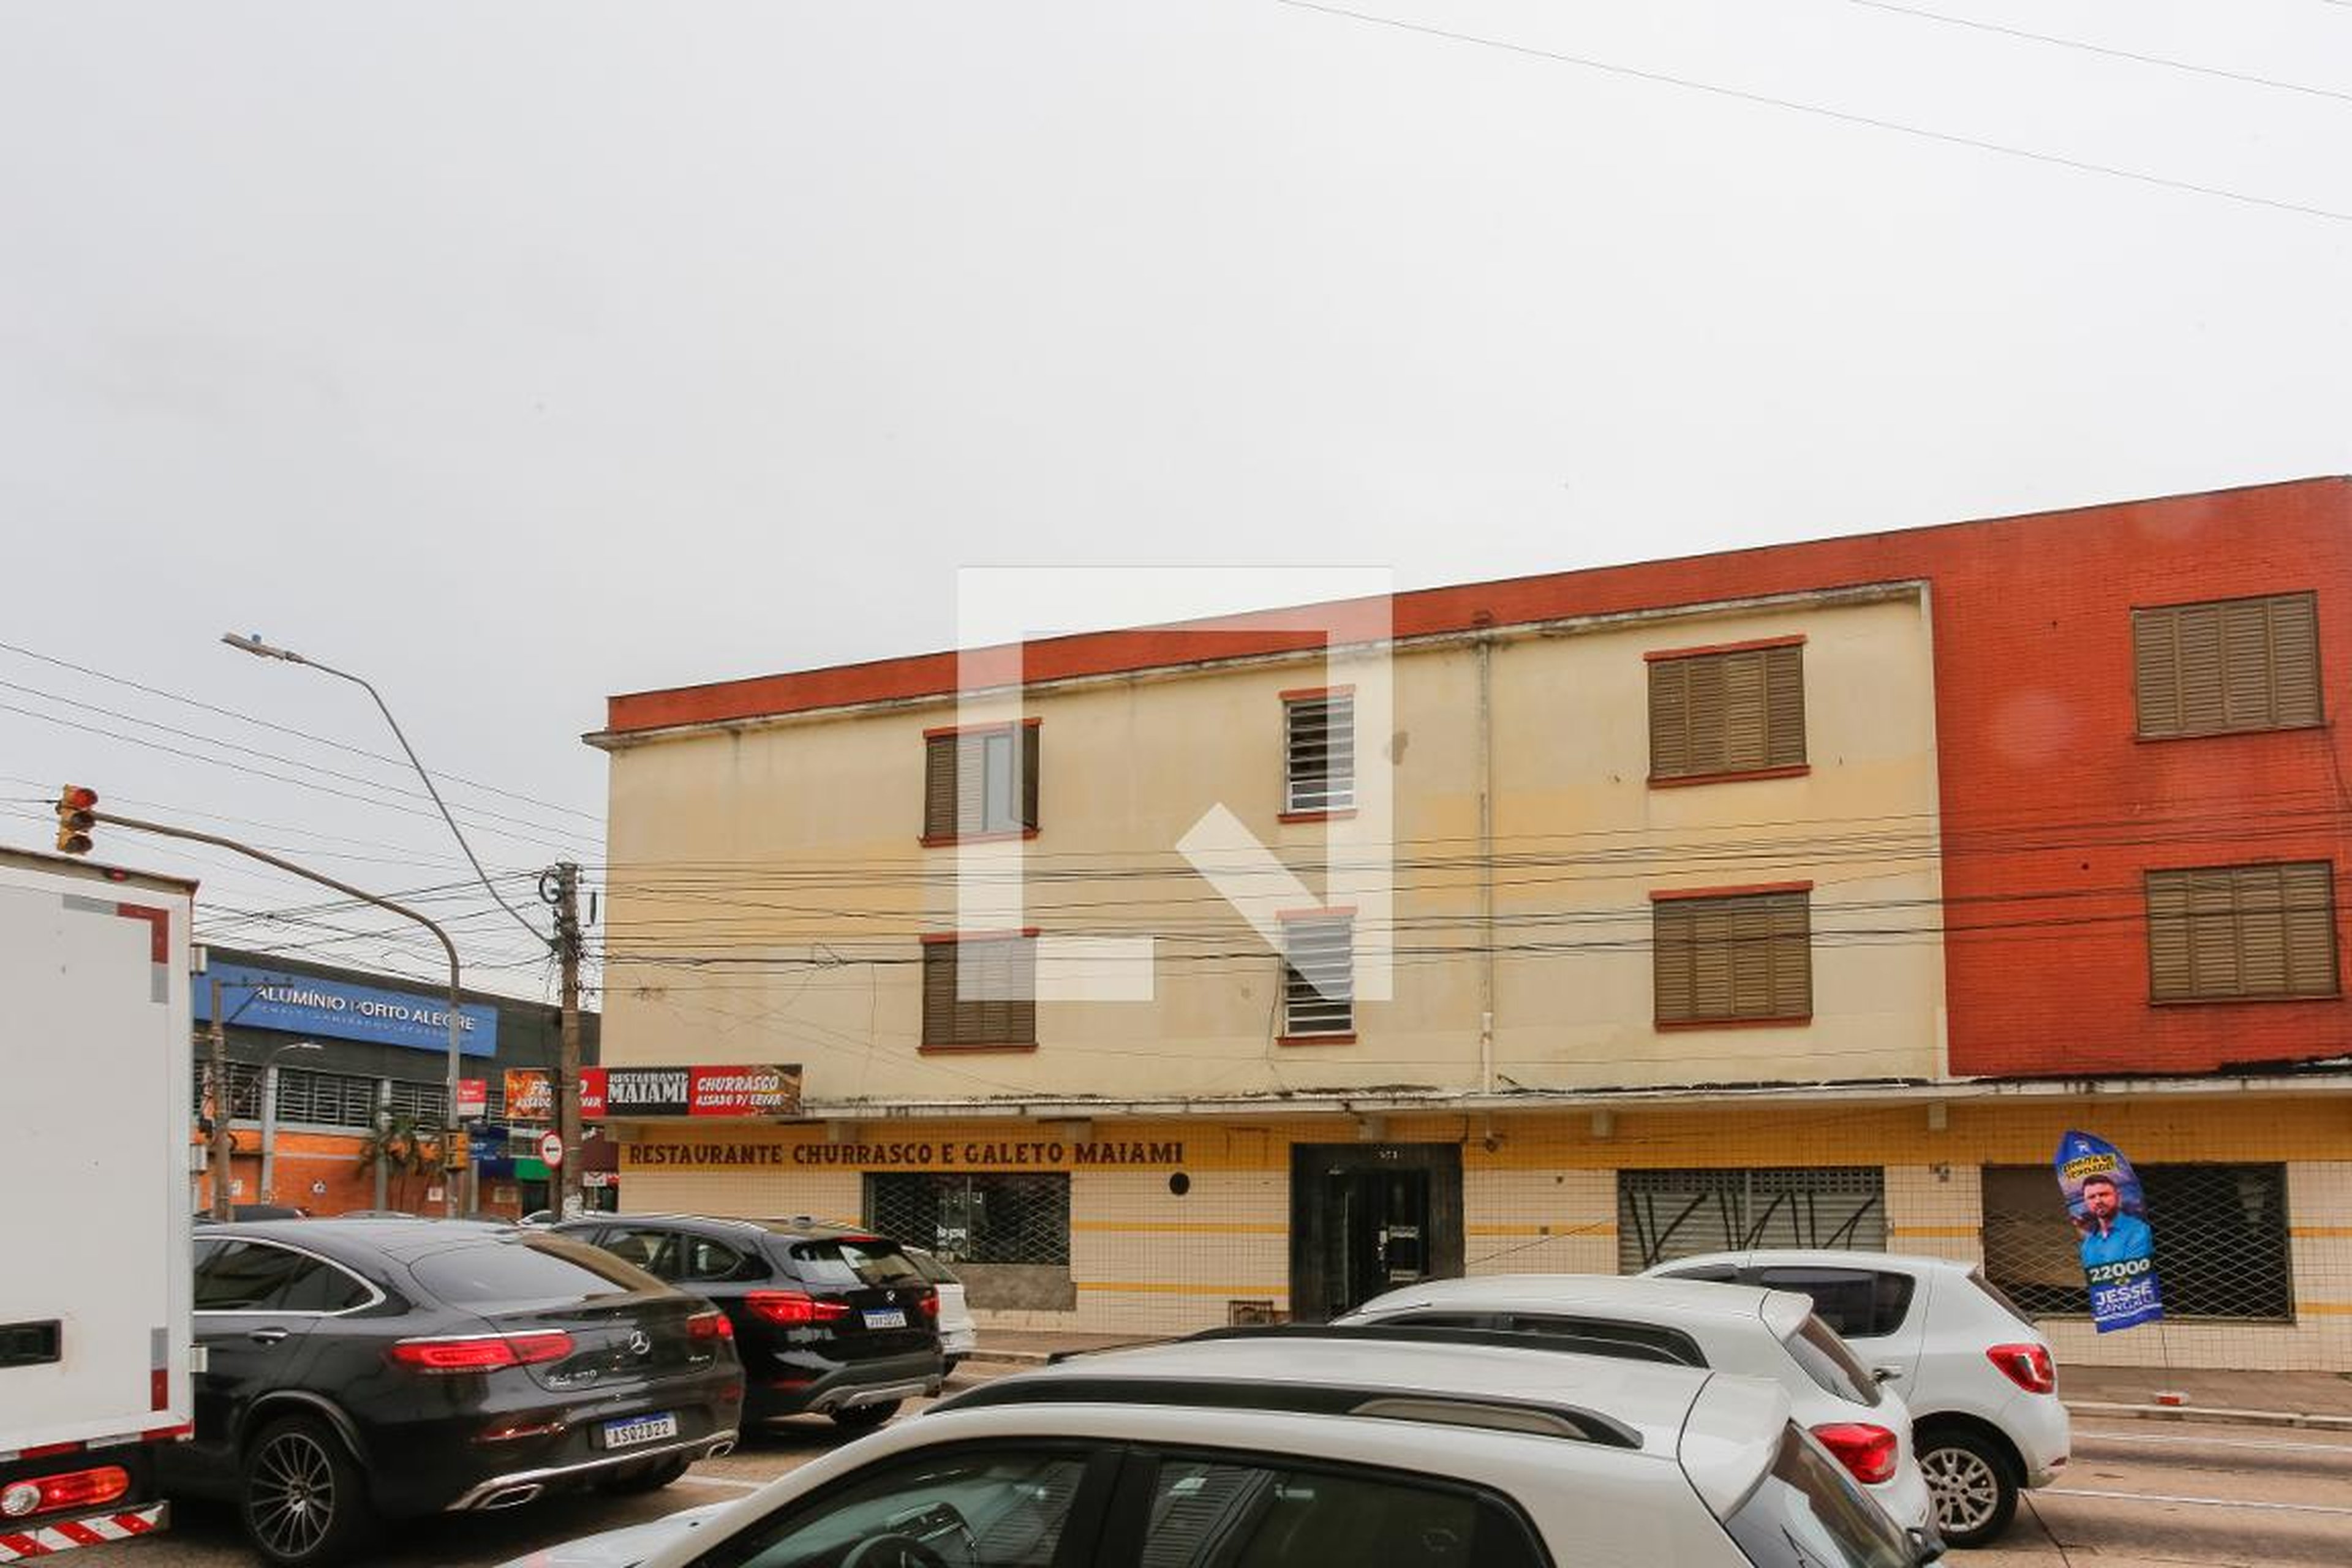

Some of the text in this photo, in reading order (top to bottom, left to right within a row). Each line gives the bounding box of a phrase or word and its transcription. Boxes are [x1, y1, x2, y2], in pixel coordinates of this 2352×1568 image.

[257, 986, 345, 1011] ALUMÍNIO
[608, 1083, 688, 1103] MAIAMI
[697, 1076, 779, 1091] CHURRASCO
[696, 1095, 733, 1106] ASSADO
[630, 1142, 1183, 1164] RESTAURANTE CHURRASCO E GALETO MAIAMI
[2089, 1258, 2150, 1283] 22000
